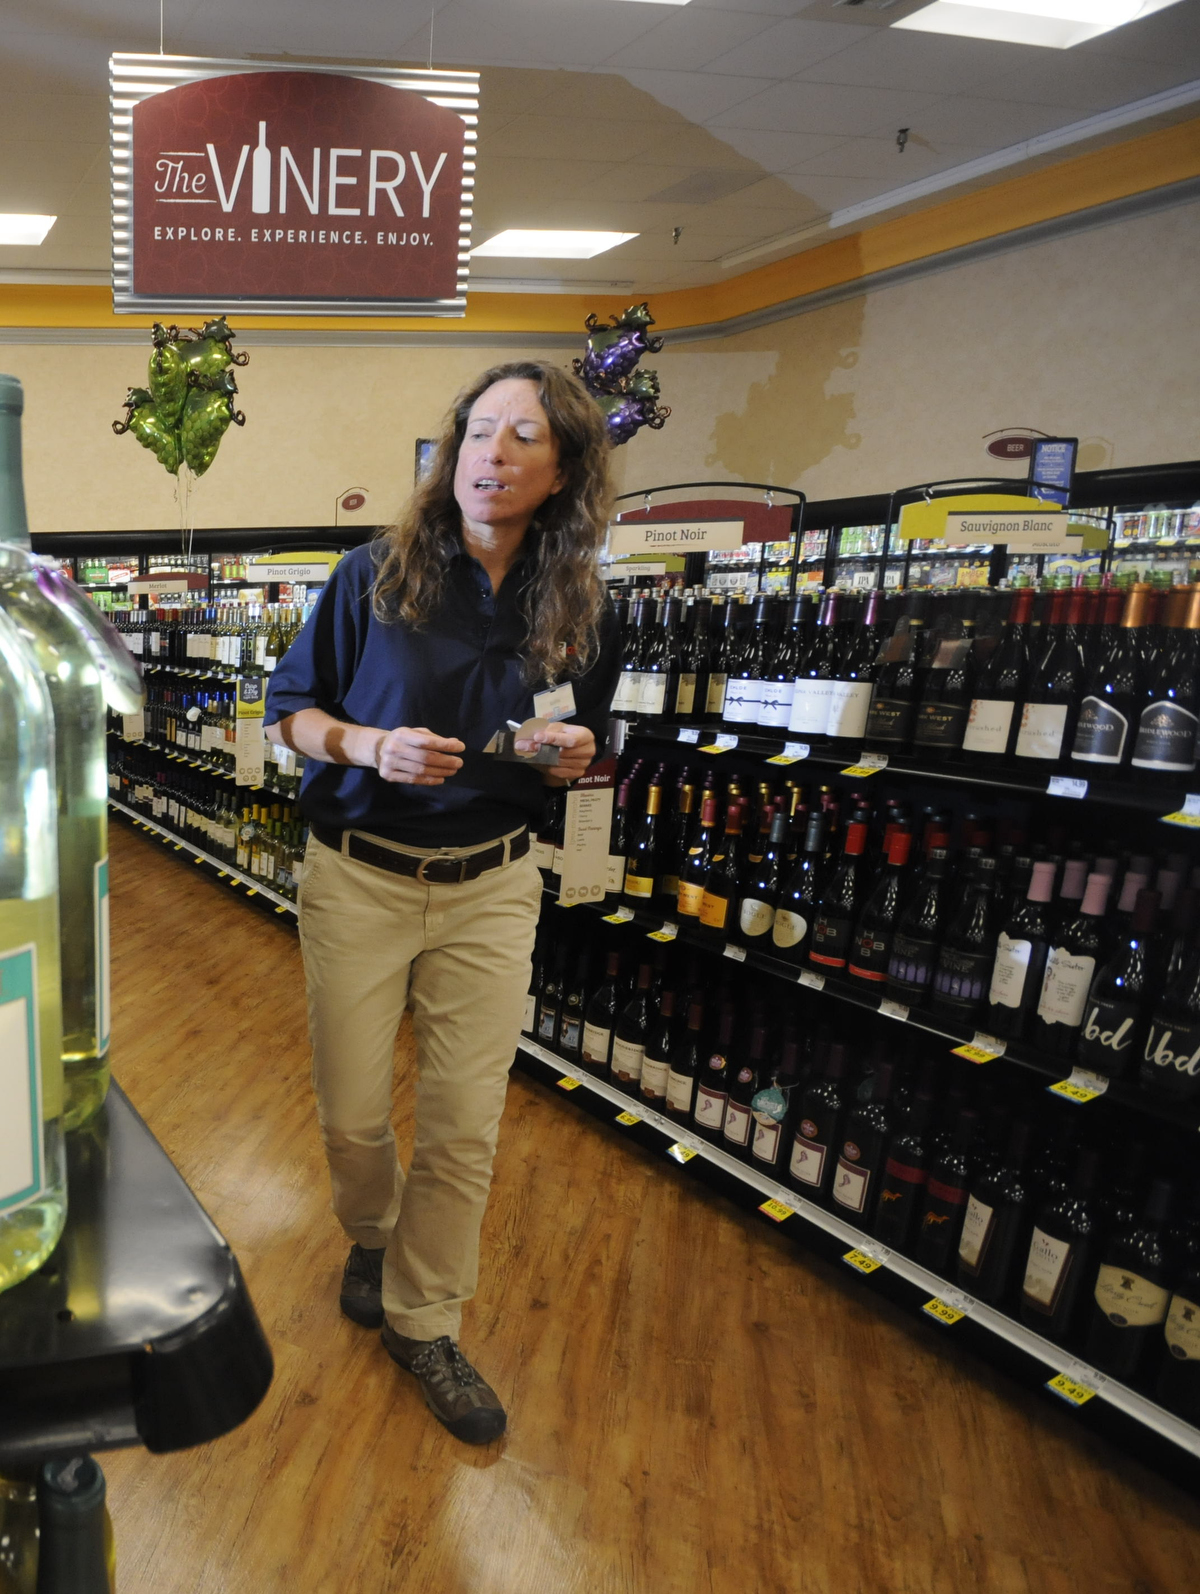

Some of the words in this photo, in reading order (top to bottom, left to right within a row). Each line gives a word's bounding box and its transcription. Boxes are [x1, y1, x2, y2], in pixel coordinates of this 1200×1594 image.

[154, 157, 207, 194] The
[154, 226, 242, 242] EXPLORE.
[251, 228, 368, 245] EXPERIENCE.
[377, 231, 435, 247] ENJOY.
[1006, 443, 1025, 452] BEER
[1041, 444, 1066, 453] NOTICE
[960, 520, 1020, 535] Sauvignon
[1021, 520, 1054, 532] Blanc
[644, 530, 676, 542] Pinot
[680, 528, 707, 541] Noir
[266, 568, 287, 576] Pinot
[287, 567, 311, 577] Grigio
[625, 564, 651, 573] Sparkling
[858, 576, 870, 585] IPA
[594, 774, 611, 782] Noir
[1071, 780, 1087, 788] 14.99
[1058, 1084, 1088, 1099] 9.49
[766, 1202, 788, 1216] 10.99
[1032, 1240, 1059, 1264] Gallo
[849, 1253, 872, 1270] 7.49
[935, 1297, 950, 1309] LOW
[928, 1302, 955, 1320] 9.99
[1054, 1379, 1085, 1399] 9.49
